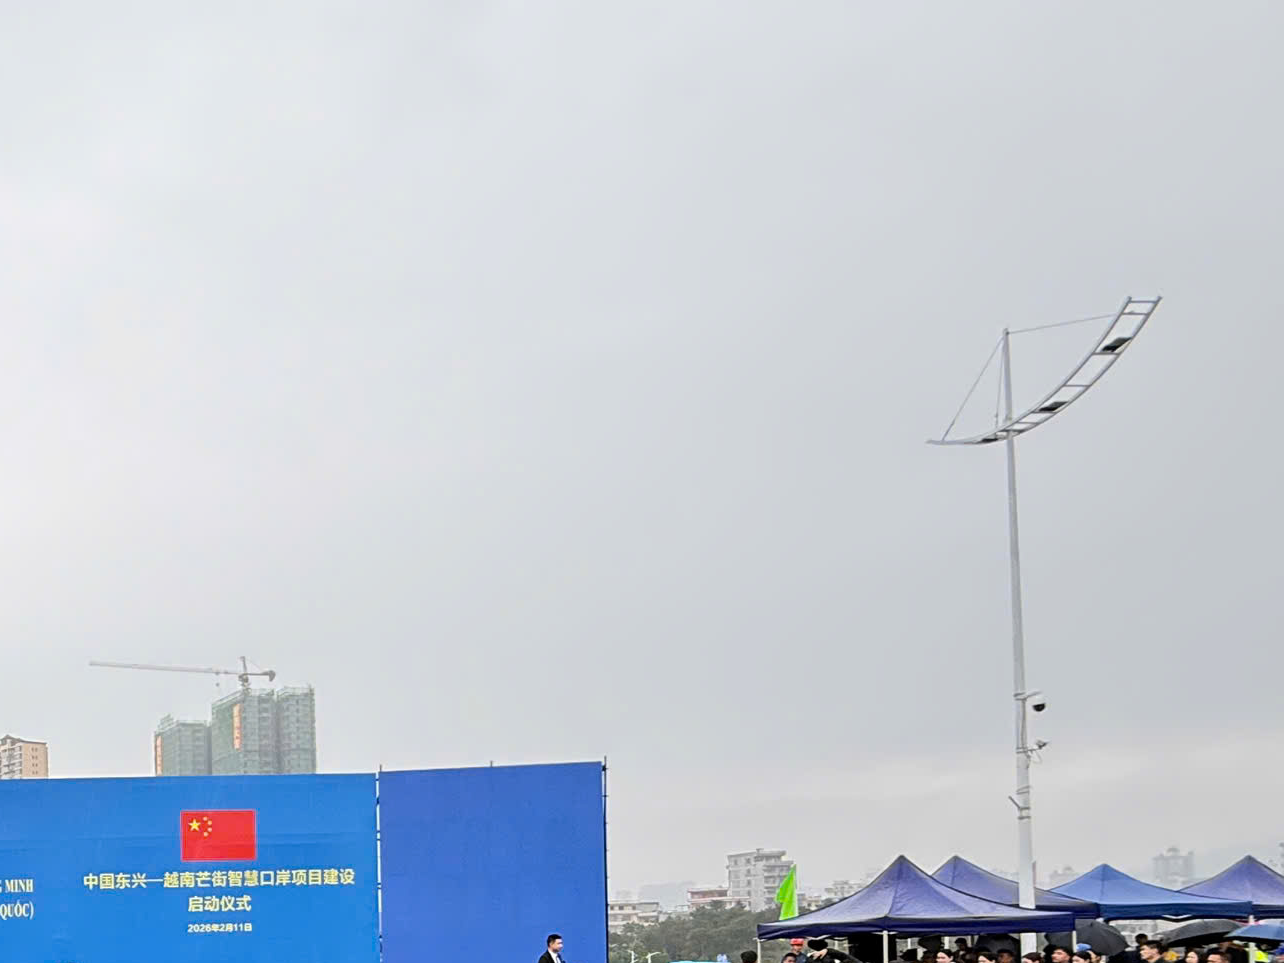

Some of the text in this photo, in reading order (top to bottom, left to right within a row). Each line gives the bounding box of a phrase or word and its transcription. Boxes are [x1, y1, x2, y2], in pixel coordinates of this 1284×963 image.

[5, 879, 34, 893] MINH
[0, 899, 34, 921] QUỐC)
[188, 895, 252, 912] 启动仪式
[187, 922, 252, 933] 2026年2月11日
